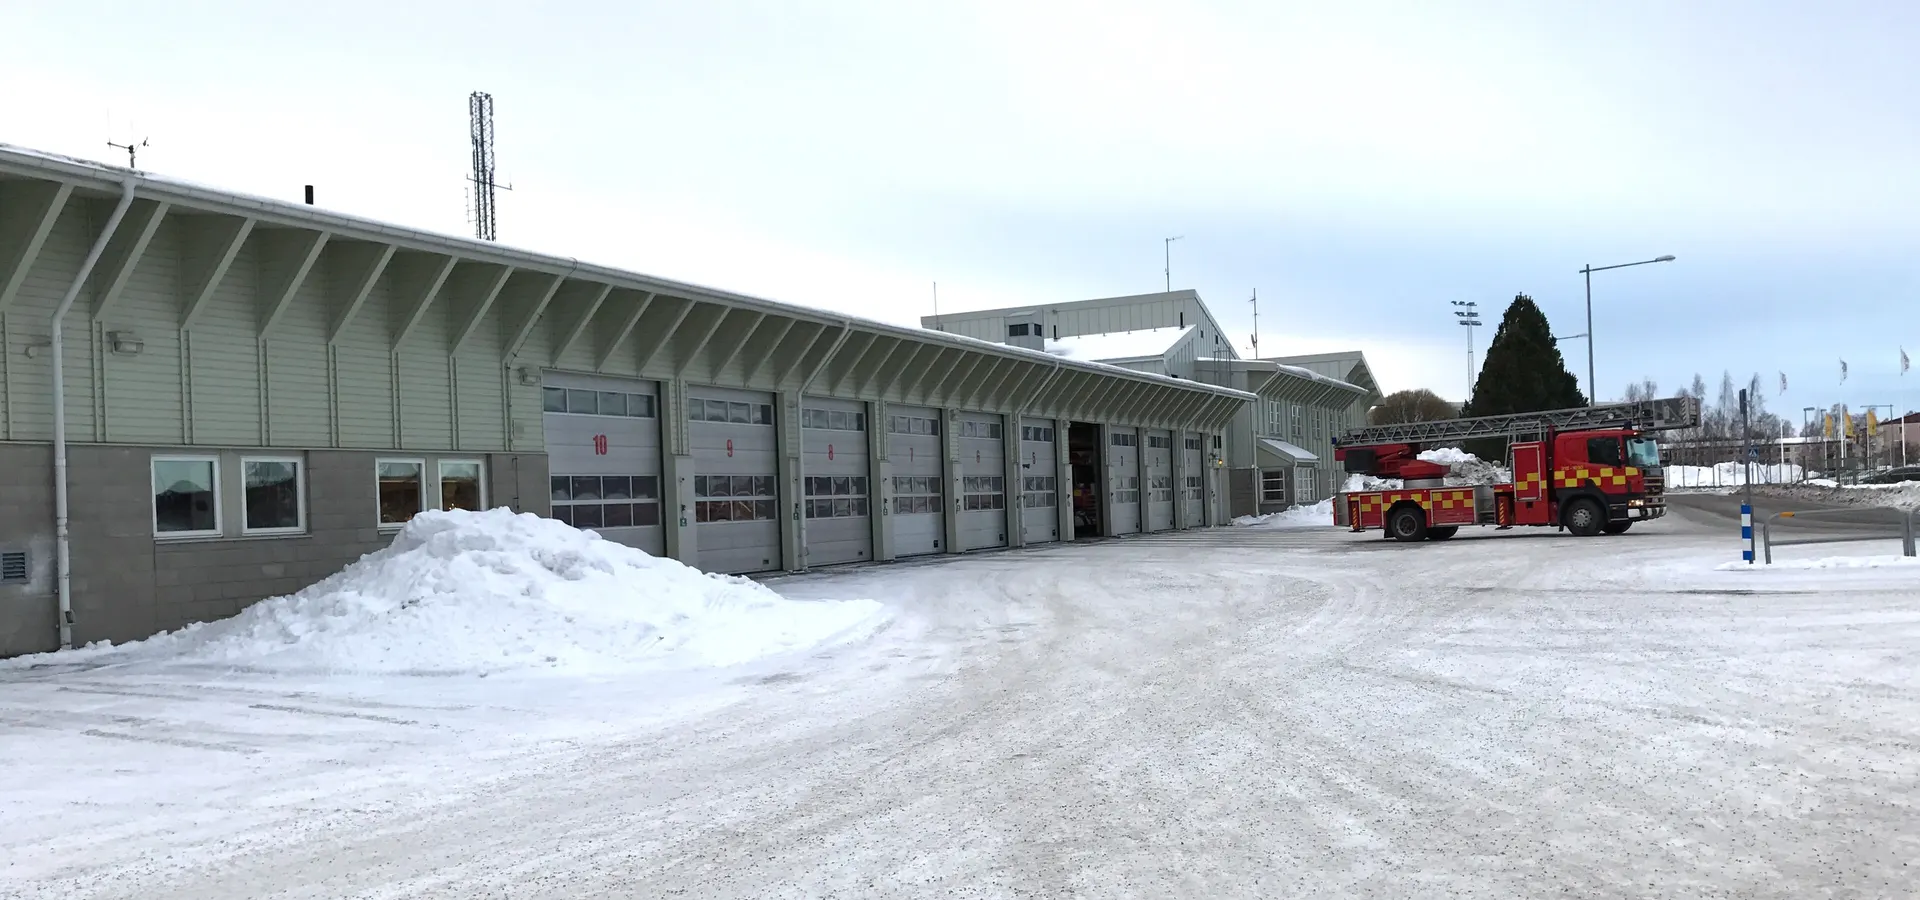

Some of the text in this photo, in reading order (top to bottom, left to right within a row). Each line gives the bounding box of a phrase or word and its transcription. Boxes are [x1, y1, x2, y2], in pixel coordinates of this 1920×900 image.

[592, 434, 607, 455] 10
[726, 439, 733, 457] 9
[828, 444, 834, 461] 8
